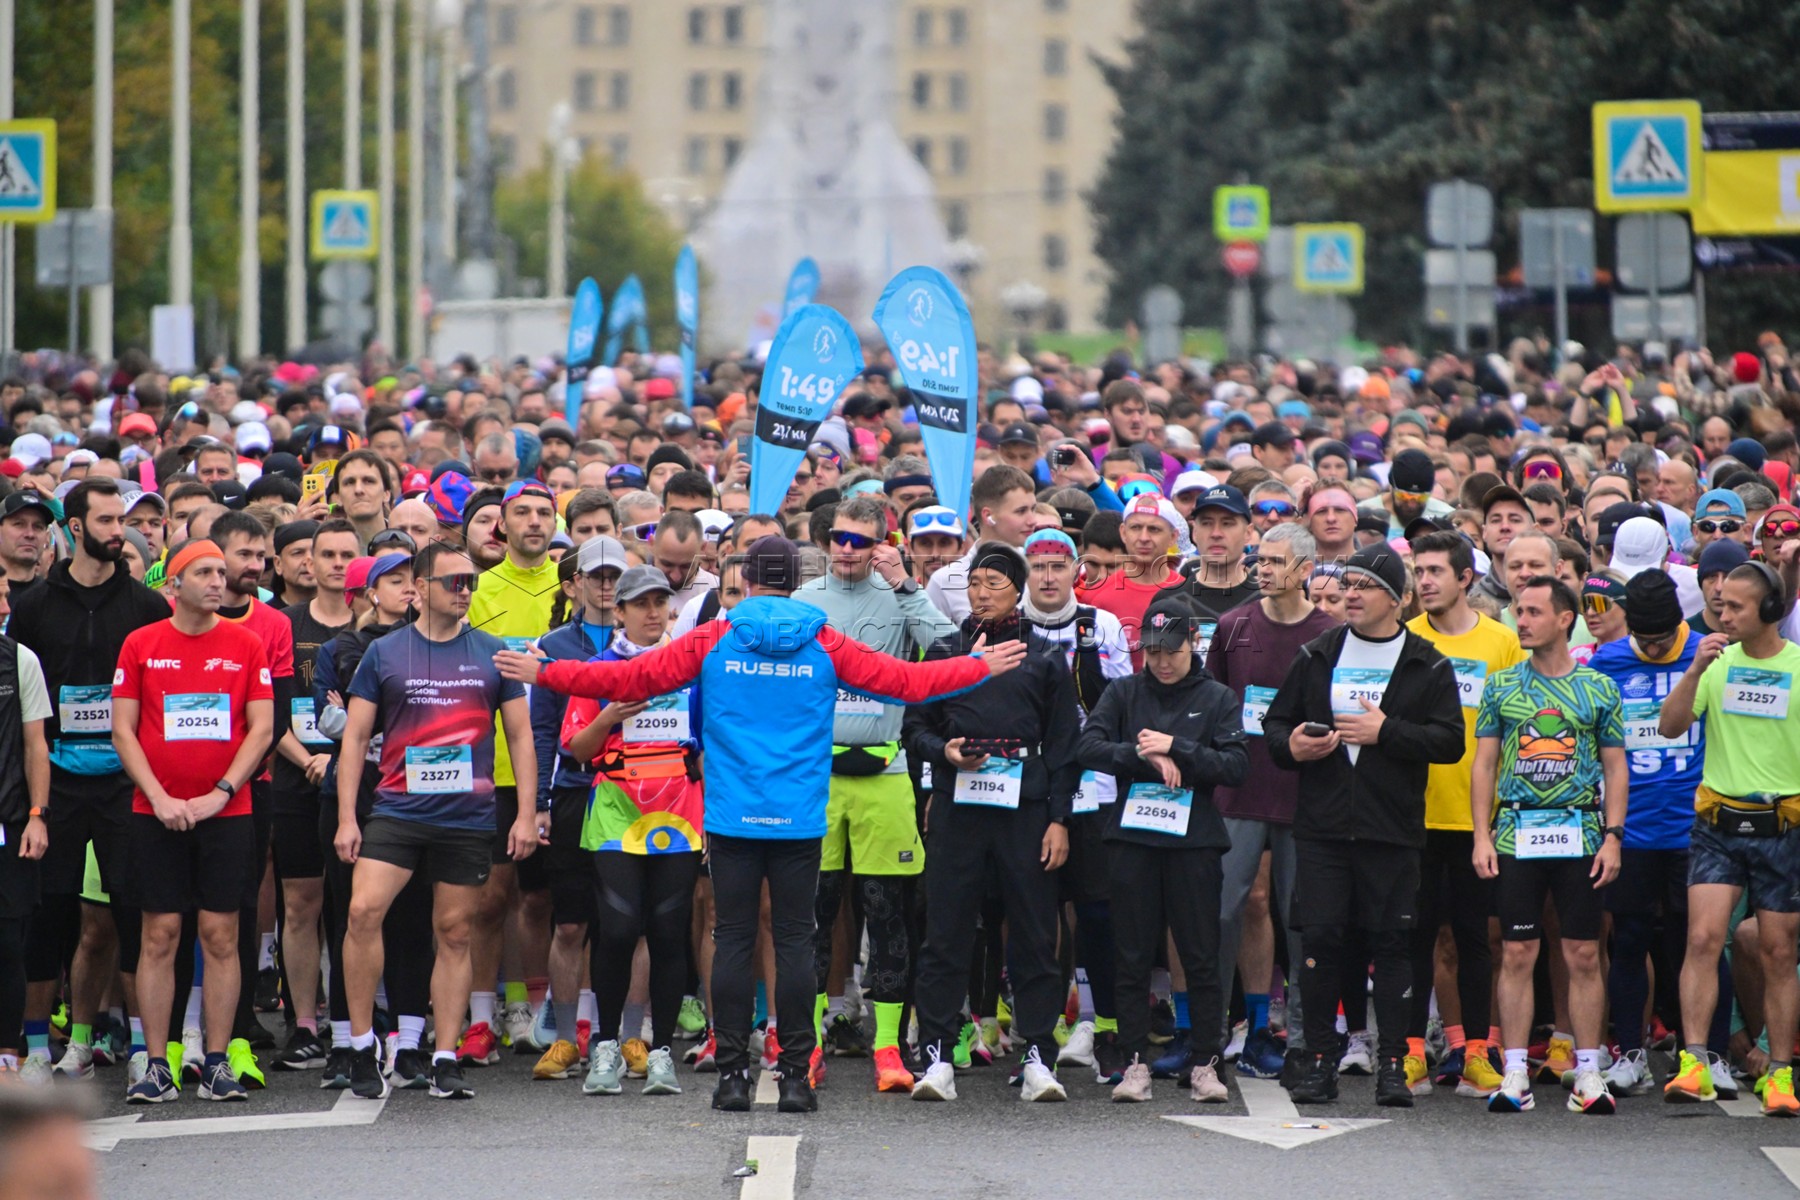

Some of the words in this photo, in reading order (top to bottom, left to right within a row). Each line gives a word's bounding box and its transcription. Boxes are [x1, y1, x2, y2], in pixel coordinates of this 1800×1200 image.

[781, 366, 835, 405] 1:49
[777, 401, 796, 414] темп
[153, 659, 181, 669] МТС
[725, 660, 813, 678] RUSSIA
[408, 679, 483, 687] ПОЛУМАРАФОН
[410, 697, 454, 706] СТОЛИЦА
[1738, 691, 1777, 704] 23257
[74, 709, 110, 721] 23521
[177, 717, 219, 728] 20254
[636, 718, 678, 729] 22099
[421, 770, 460, 781] 23277
[1533, 773, 1557, 781] БЕГУТ
[970, 780, 1005, 793] 21194
[1136, 806, 1177, 820] 22694
[741, 816, 792, 824] NORDSKI
[1530, 834, 1569, 845] 23416
